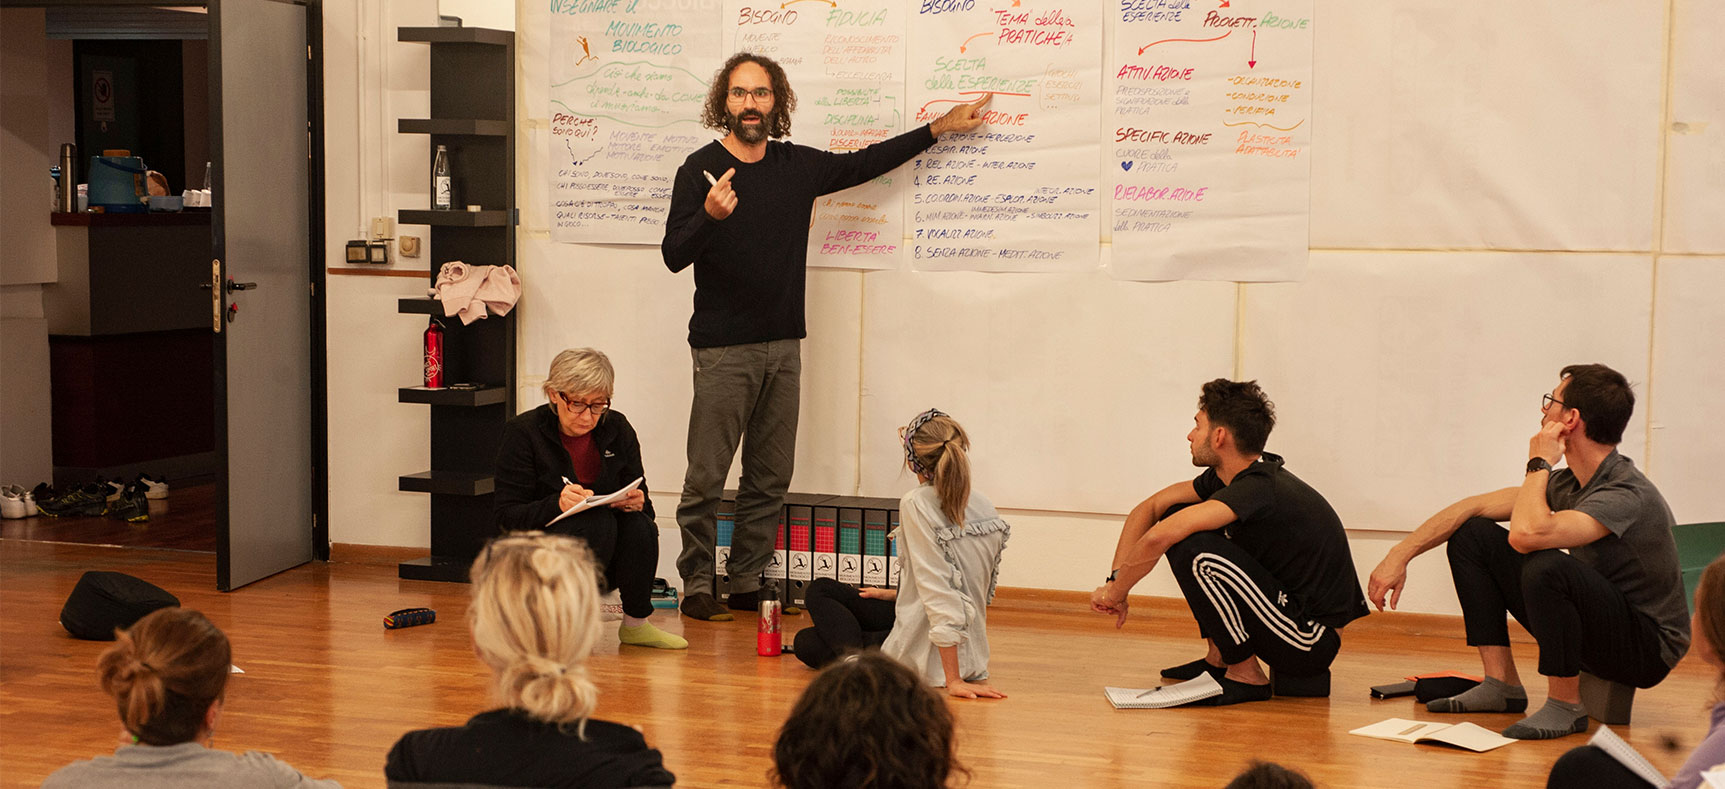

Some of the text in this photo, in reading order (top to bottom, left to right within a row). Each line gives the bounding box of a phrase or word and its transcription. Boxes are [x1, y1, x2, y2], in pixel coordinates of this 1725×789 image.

[920, 0, 975, 14] BISOGNO
[738, 7, 798, 25] BISOGNO
[826, 8, 887, 27] FIDUCIA
[1123, 11, 1181, 22] ESPERIENZE
[605, 20, 682, 38] MOVIMENTO
[612, 39, 682, 55] BIOLOGICO
[934, 56, 986, 72] SCELTA
[958, 74, 1037, 93] ESPERIENZE
[824, 113, 874, 126] DISCIPLINA
[1136, 162, 1178, 173] PRATICA
[1115, 207, 1194, 219] SEDIMENTAZIONE
[1132, 221, 1171, 232] PRATICA
